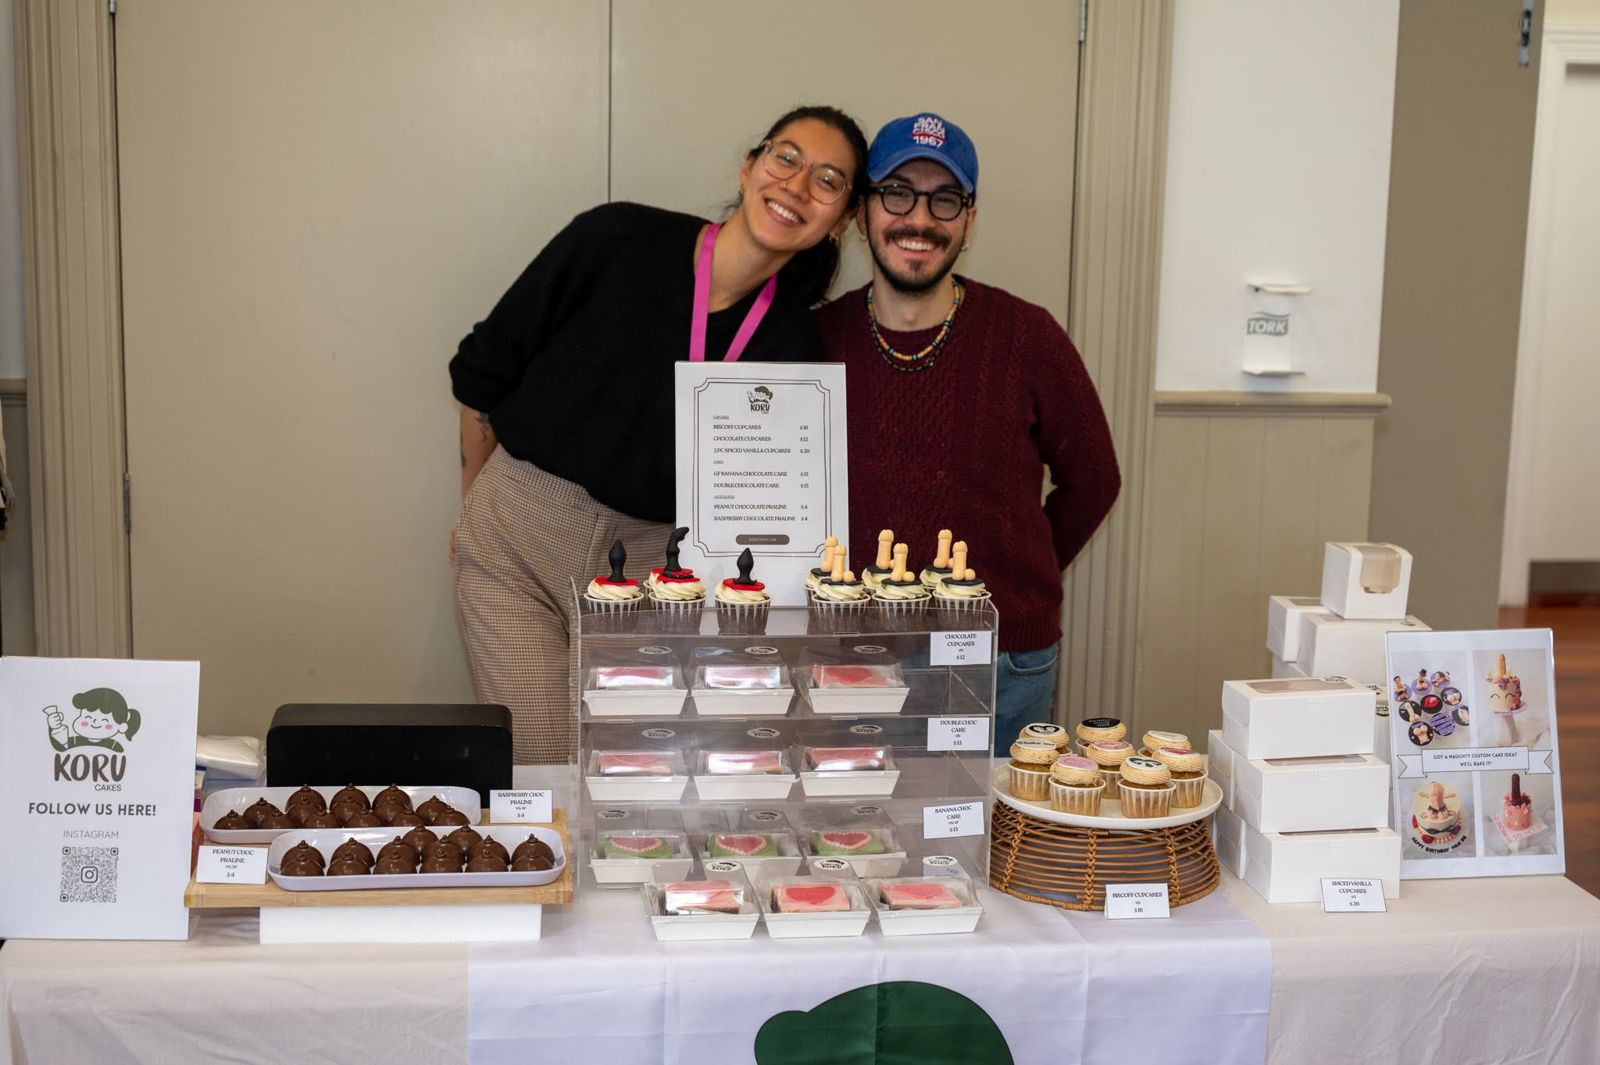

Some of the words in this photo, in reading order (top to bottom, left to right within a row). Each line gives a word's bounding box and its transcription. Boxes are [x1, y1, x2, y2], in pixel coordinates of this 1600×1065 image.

[913, 136, 944, 148] 1967
[1249, 320, 1287, 333] TORK
[54, 753, 127, 782] KORU
[94, 784, 122, 792] CAKES
[29, 803, 91, 815] FOLLOW
[95, 804, 112, 816] US
[118, 804, 157, 816] HERE!
[63, 830, 120, 839] INSTAGRAM
